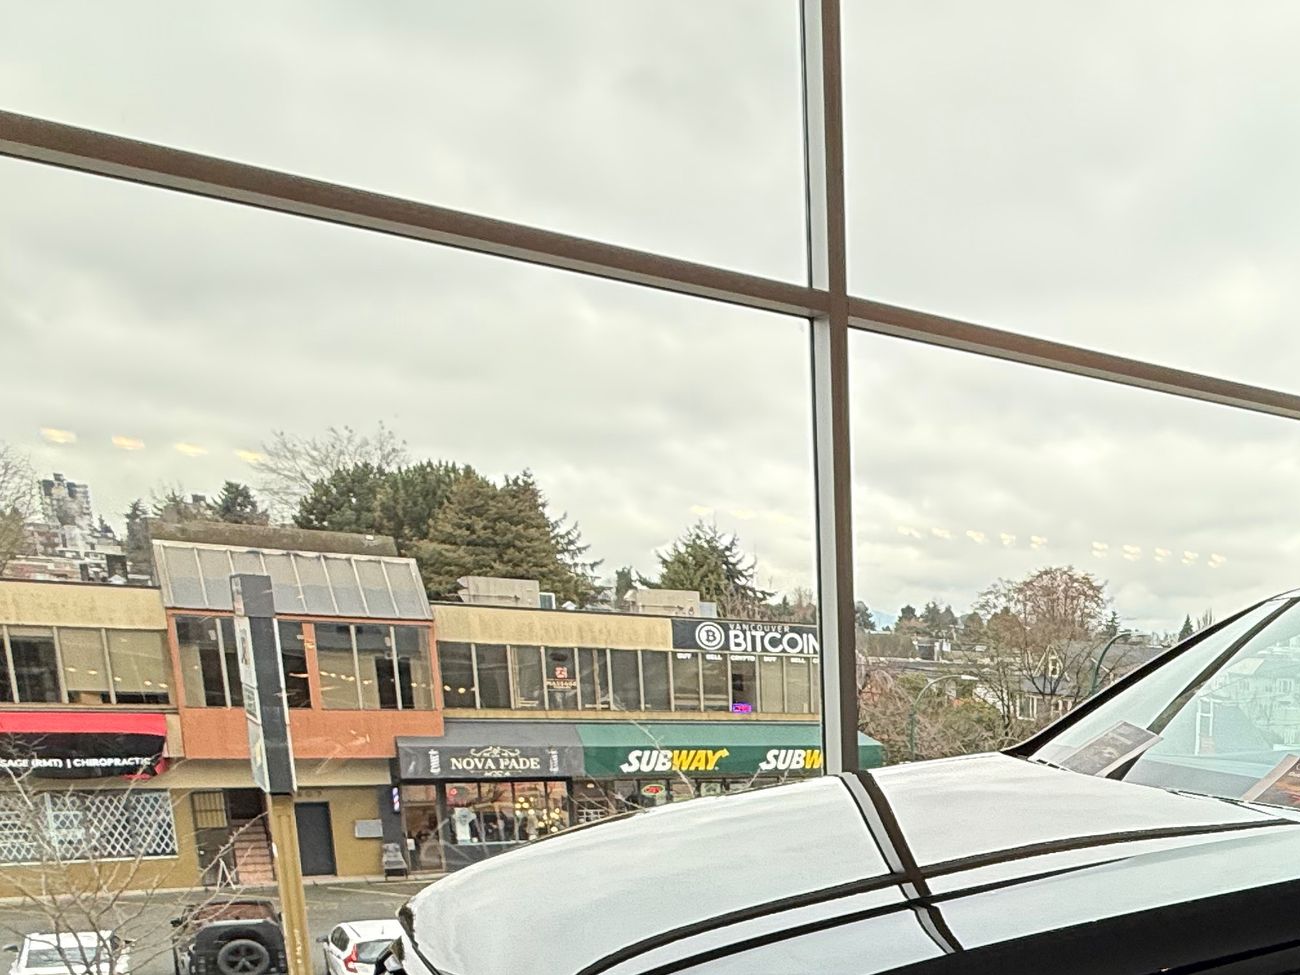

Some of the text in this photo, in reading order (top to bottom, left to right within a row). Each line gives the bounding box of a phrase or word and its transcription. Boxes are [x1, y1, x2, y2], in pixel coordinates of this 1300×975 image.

[729, 623, 790, 633] VANCOUVER
[31, 758, 63, 769] (RMT)
[73, 757, 151, 768] CHIROPRACTIC
[450, 757, 496, 770] NOVA
[620, 748, 729, 773] SUBWAY
